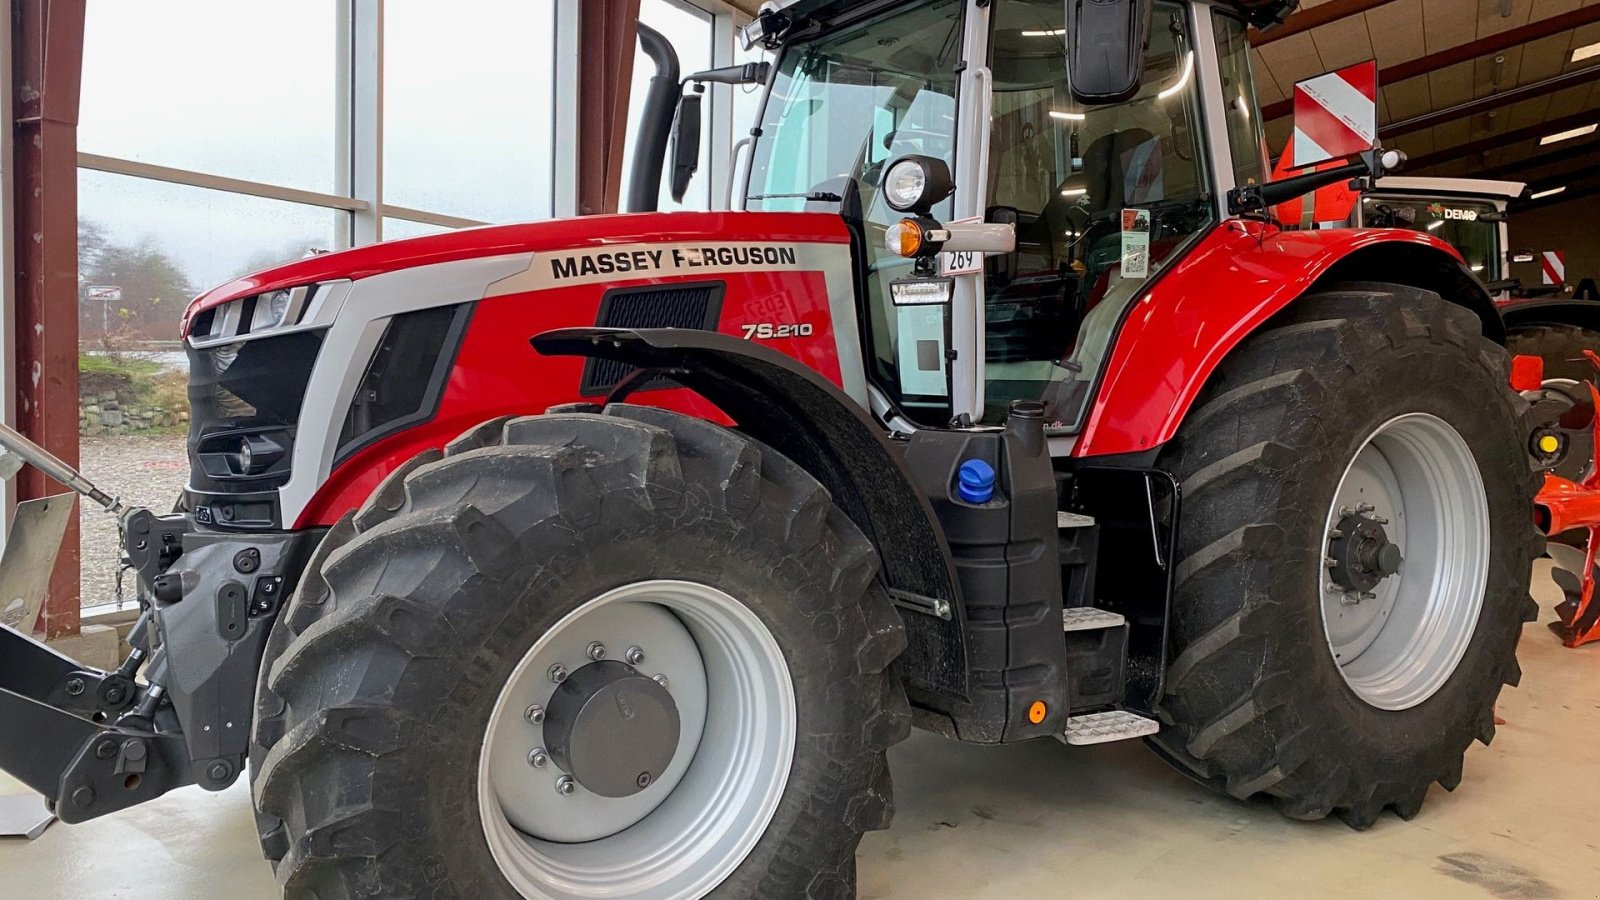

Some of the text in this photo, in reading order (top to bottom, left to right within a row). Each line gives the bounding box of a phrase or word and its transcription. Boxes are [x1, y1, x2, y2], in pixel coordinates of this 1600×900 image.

[1444, 208, 1477, 221] DEMO
[551, 247, 796, 279] MASSEY FERGUSON
[950, 251, 973, 271] 269
[740, 323, 813, 340] 7S.210
